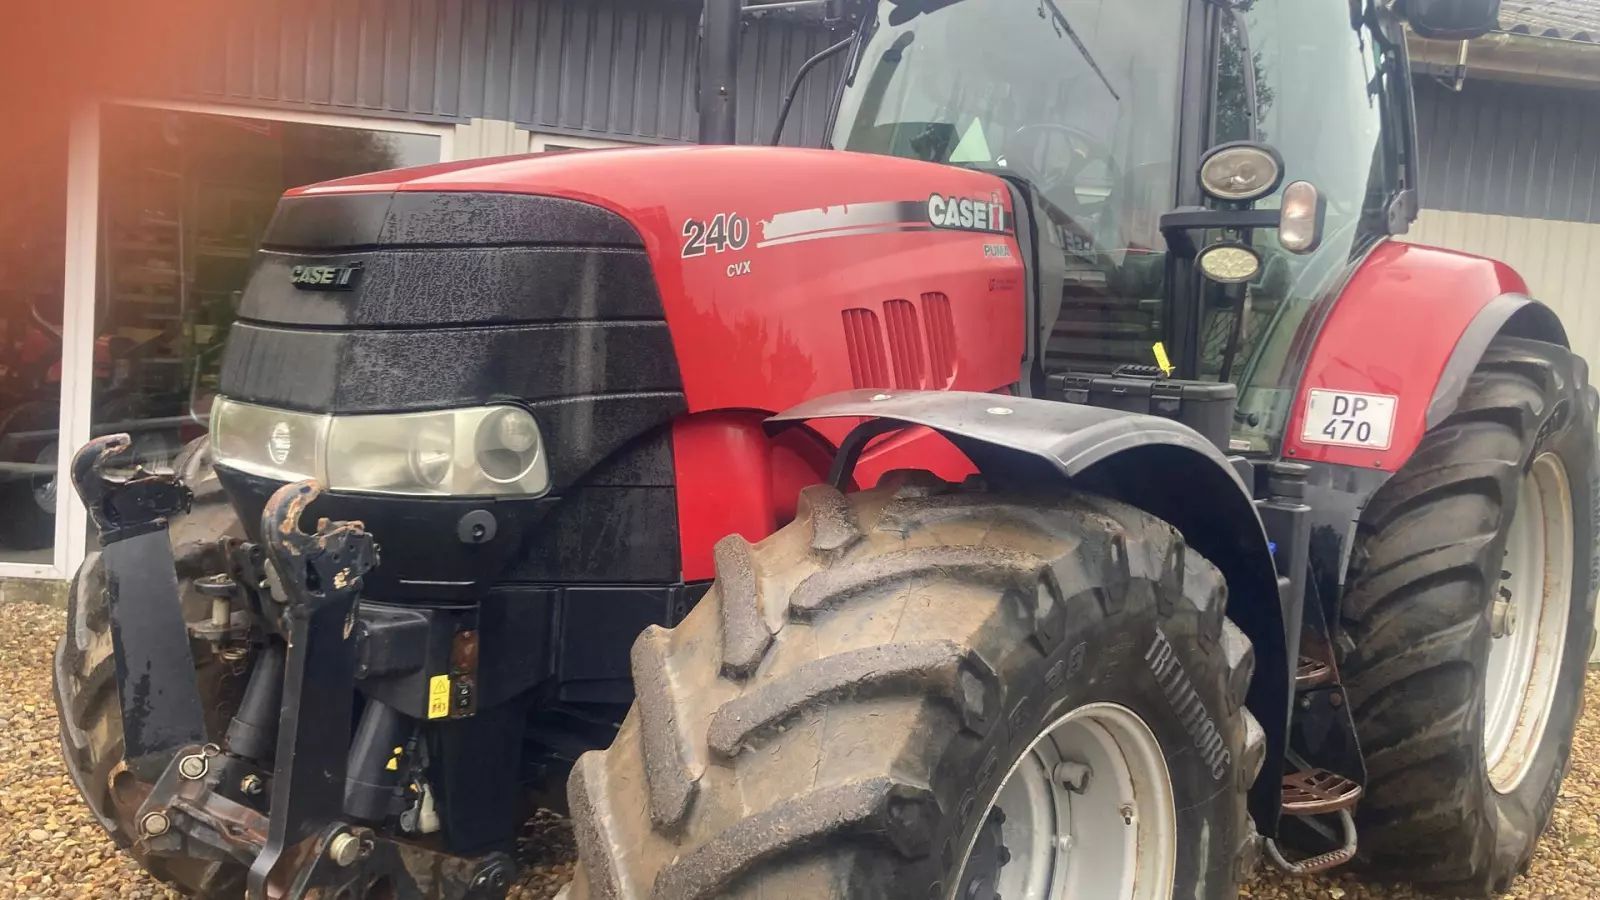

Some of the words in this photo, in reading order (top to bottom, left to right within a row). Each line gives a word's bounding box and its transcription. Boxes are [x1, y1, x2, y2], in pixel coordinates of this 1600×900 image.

[928, 193, 987, 229] CASE
[681, 212, 749, 258] 240
[289, 265, 335, 284] CASE
[726, 260, 751, 278] CVX
[1332, 395, 1369, 417] DP
[1322, 418, 1371, 443] 470
